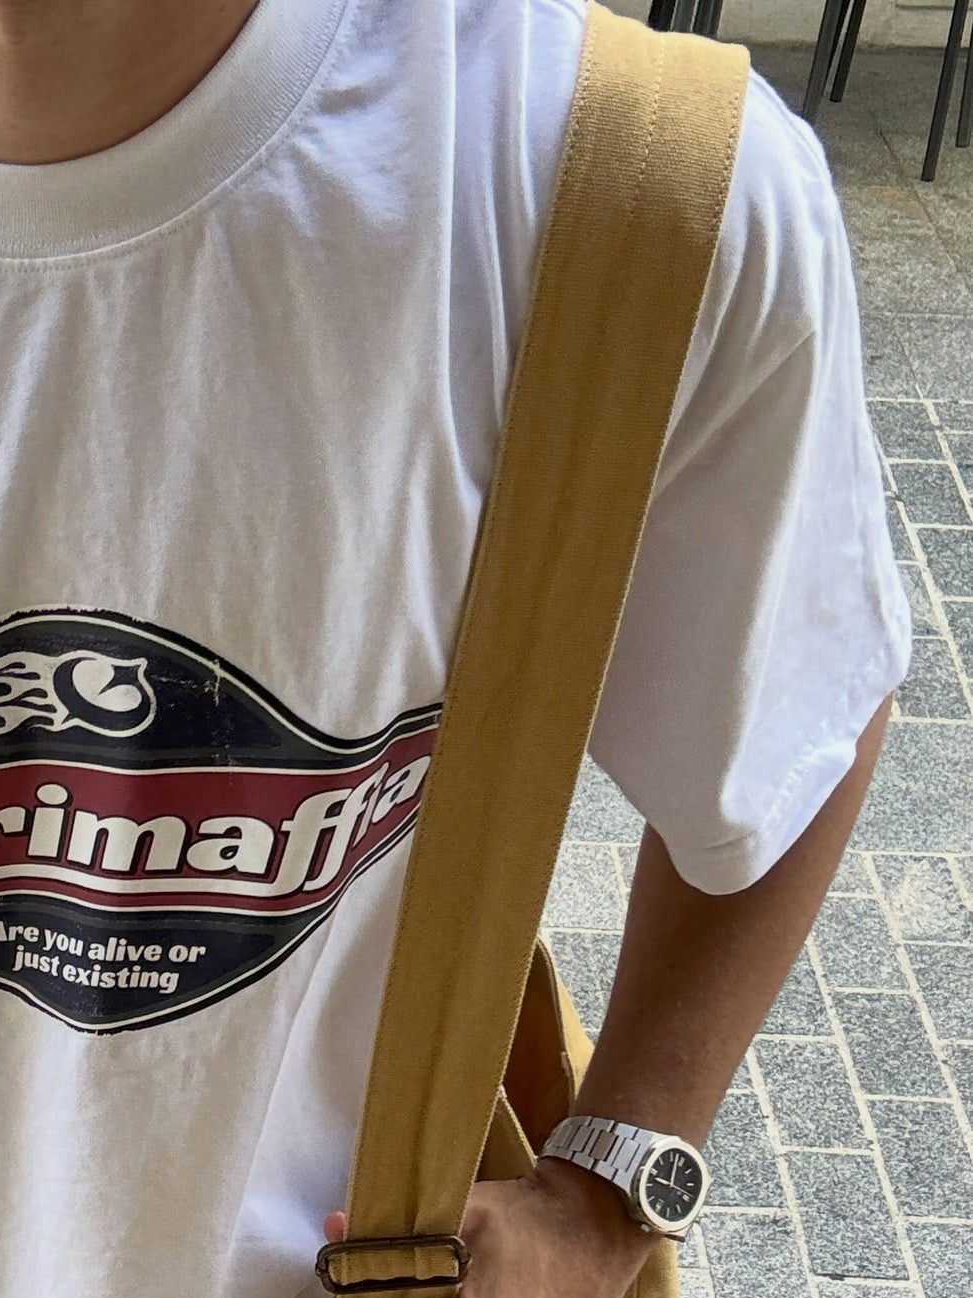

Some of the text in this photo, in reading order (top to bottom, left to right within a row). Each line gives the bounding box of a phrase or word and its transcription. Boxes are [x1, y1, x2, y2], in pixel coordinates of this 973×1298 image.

[42, 928, 84, 956] you
[87, 937, 161, 962] alive
[168, 944, 206, 963] or
[12, 945, 179, 994] just existing
